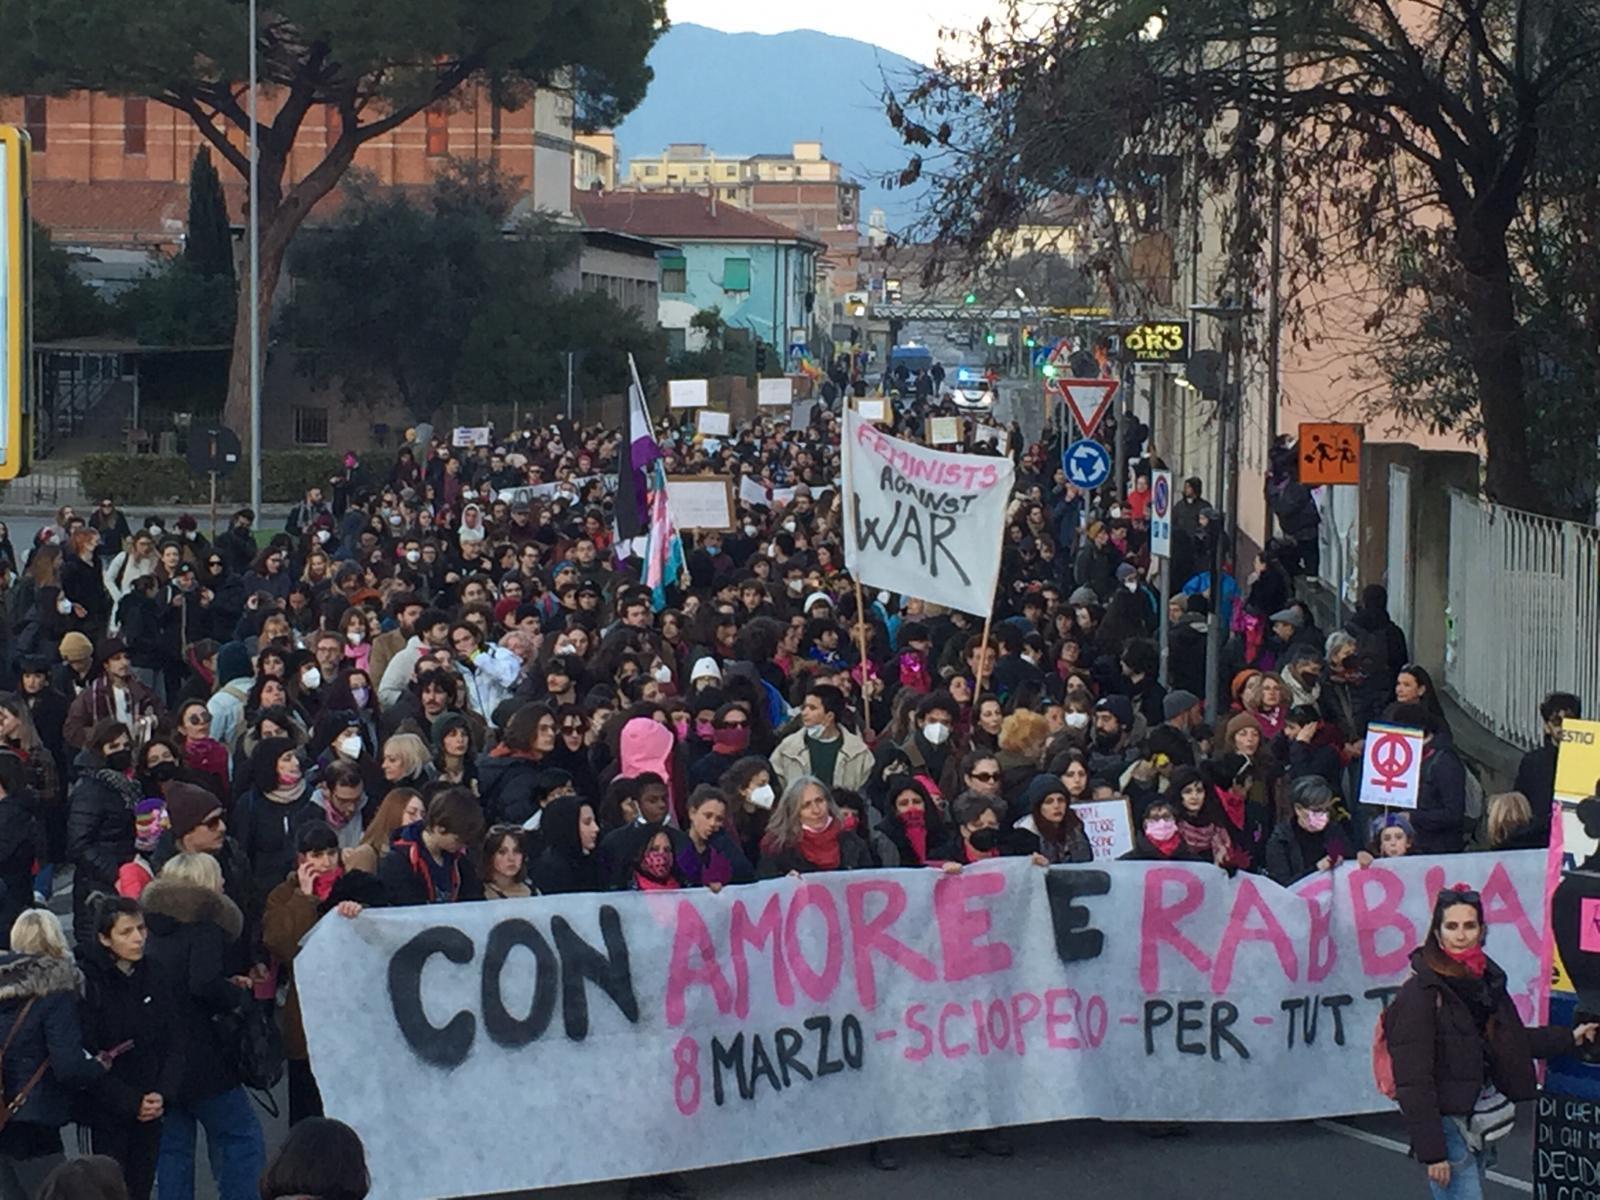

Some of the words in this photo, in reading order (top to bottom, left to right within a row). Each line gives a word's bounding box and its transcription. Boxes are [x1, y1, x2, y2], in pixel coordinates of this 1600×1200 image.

[1125, 334, 1183, 351] ORO
[857, 423, 998, 490] FEMINISTS
[880, 465, 978, 514] AGAINST
[853, 492, 971, 586] WAR
[387, 904, 639, 1069] CON
[666, 872, 1013, 1027] AMORE
[1046, 869, 1111, 962] E
[673, 1036, 700, 1116] 8
[711, 1014, 864, 1106] MARZO
[1143, 1000, 1250, 1060] PER
[1540, 1097, 1556, 1117] DI
[1565, 1102, 1590, 1122] CHE
[1540, 1123, 1553, 1145] DI
